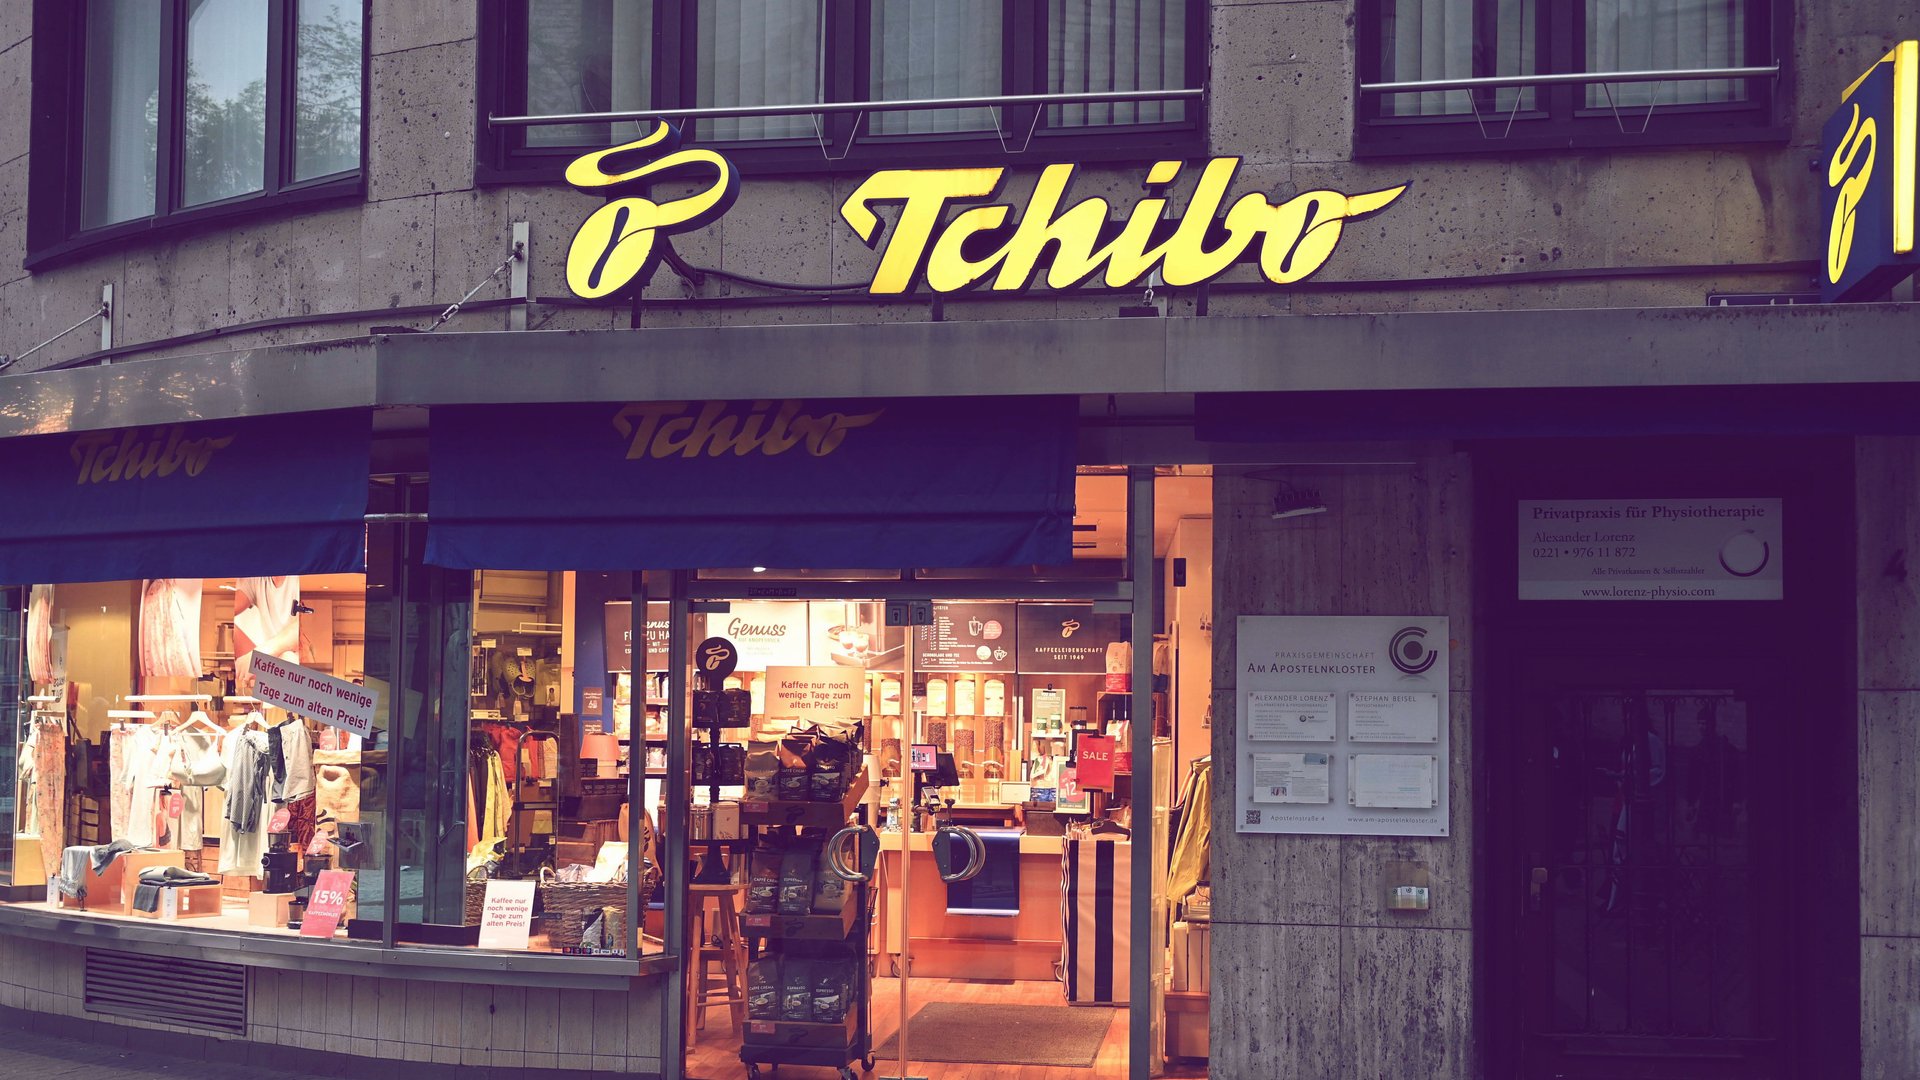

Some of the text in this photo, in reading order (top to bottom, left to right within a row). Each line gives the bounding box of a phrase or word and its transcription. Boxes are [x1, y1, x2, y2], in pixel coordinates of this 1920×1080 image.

[841, 155, 1413, 296] Tchibo
[613, 400, 886, 459] Tchibo
[70, 428, 237, 485] Tchibo
[1533, 505, 1765, 522] Privatpraxis für Physiotherapie
[1533, 531, 1635, 543] Alexander Lorenz
[1533, 547, 1559, 558] 0221
[1573, 547, 1594, 558] 976
[1598, 547, 1610, 558] 11
[1615, 547, 1636, 558] 872
[1662, 566, 1704, 575] Selbstzahler
[1582, 586, 1715, 600] www.lorenz-physio.com
[728, 617, 786, 640] Genuss
[254, 657, 372, 708] Kaffee nur noch wenige
[778, 691, 807, 700] wenige
[810, 691, 829, 700] Tage
[259, 682, 368, 730] Tage zum alten Preis!
[1082, 751, 1108, 760] SALE
[314, 890, 343, 905] 15%
